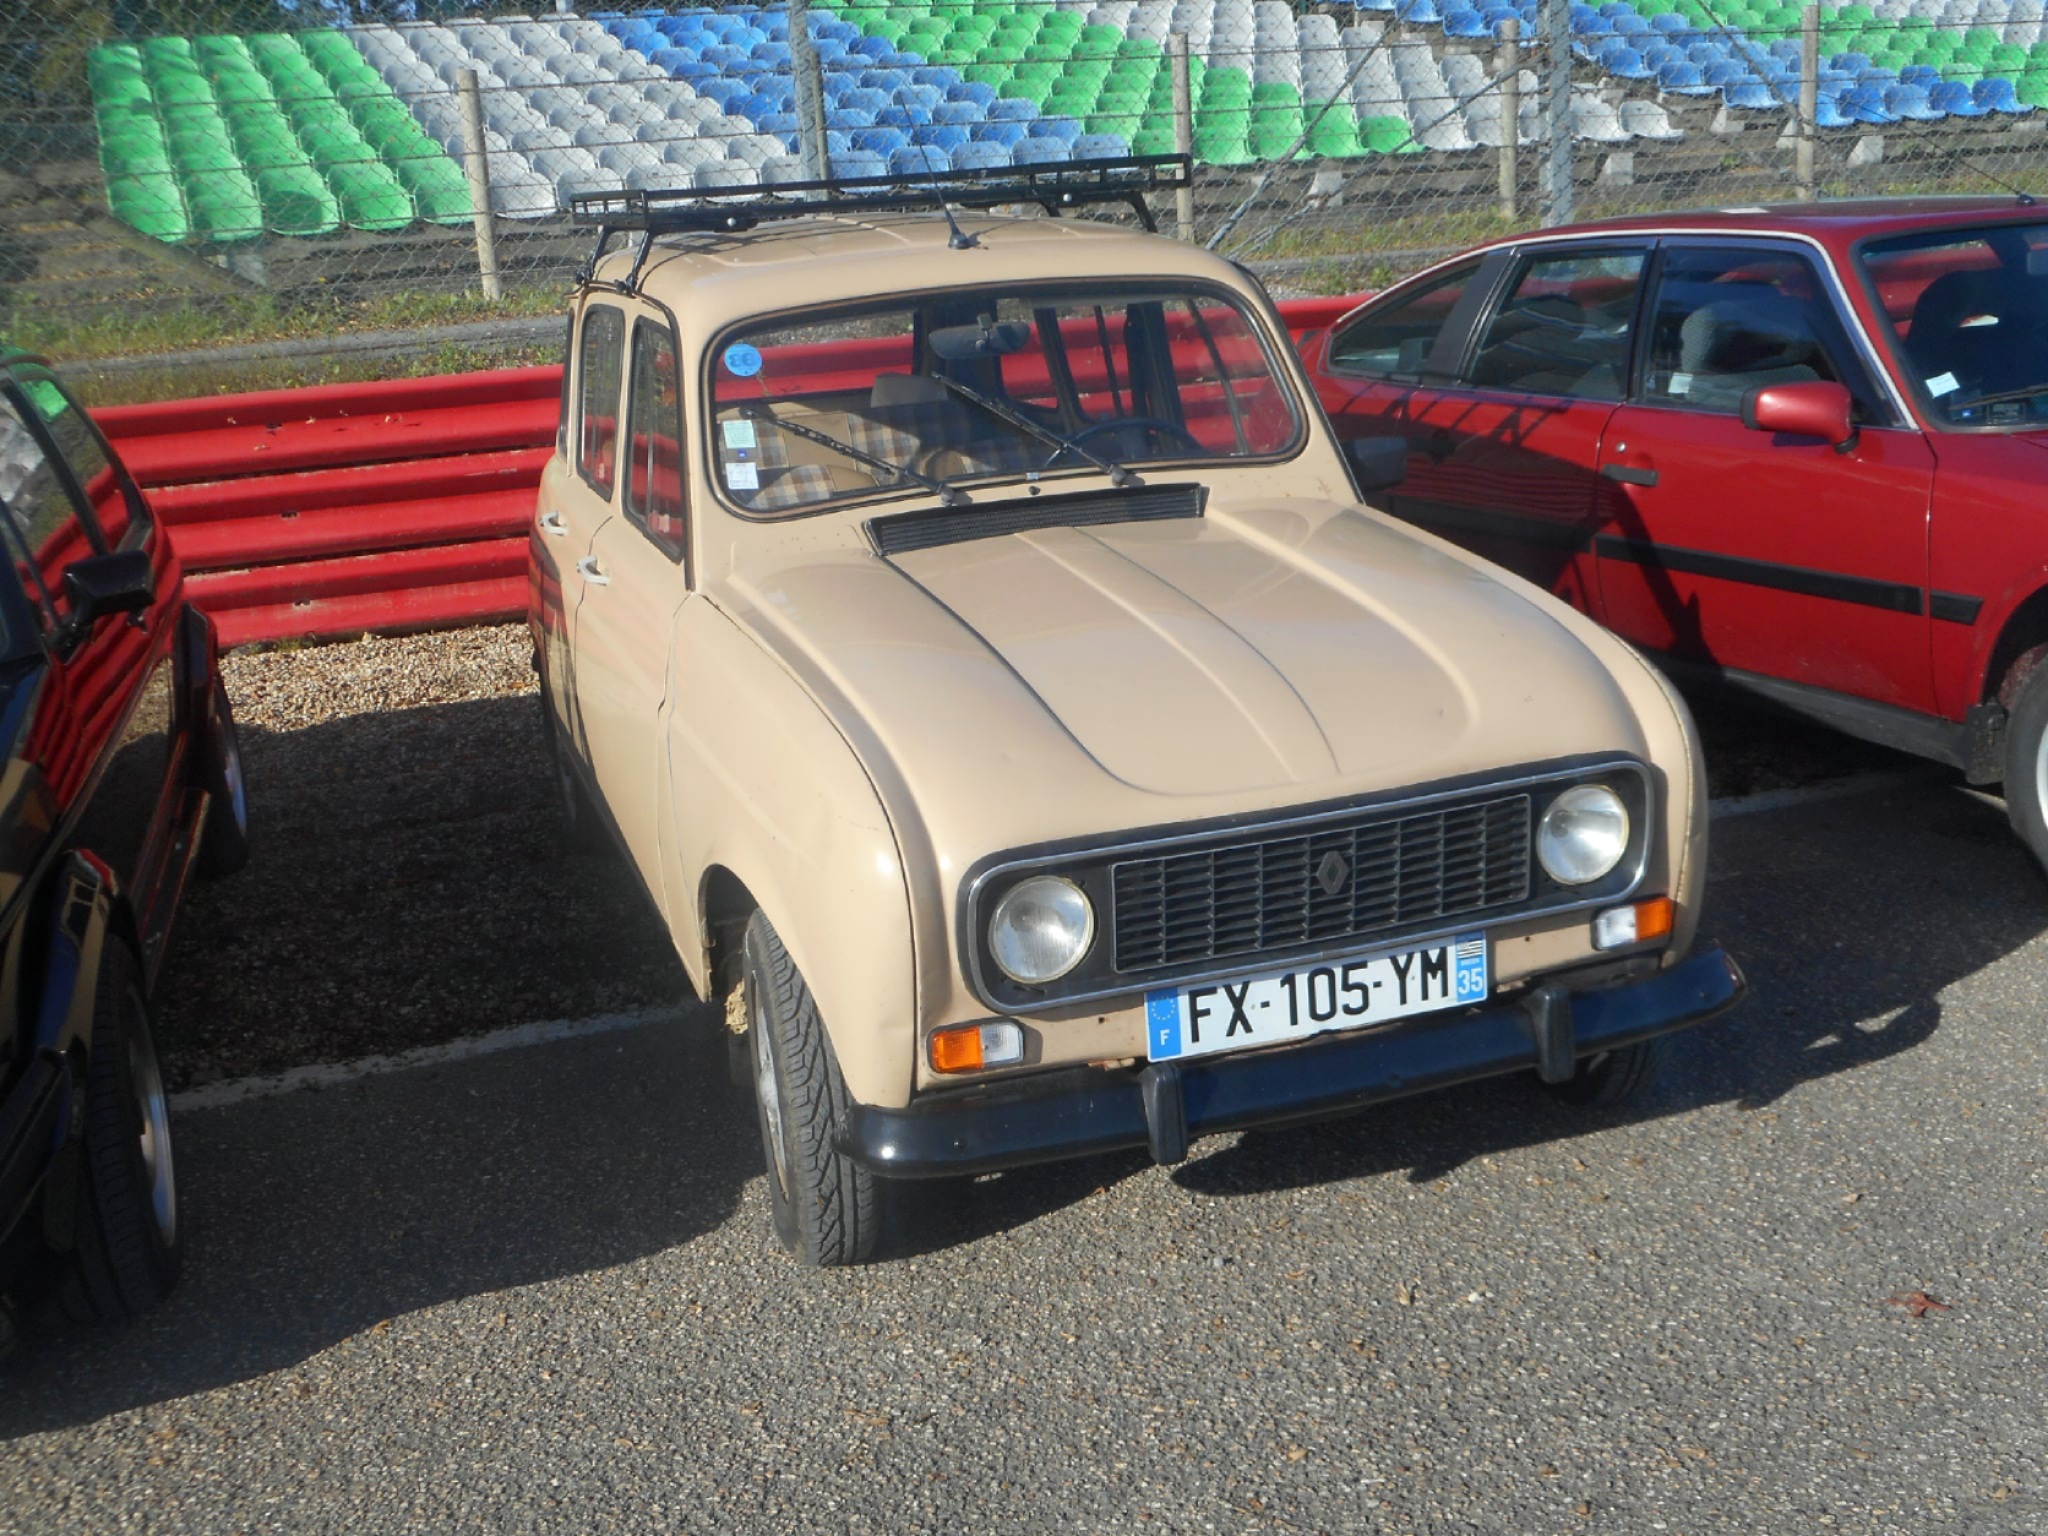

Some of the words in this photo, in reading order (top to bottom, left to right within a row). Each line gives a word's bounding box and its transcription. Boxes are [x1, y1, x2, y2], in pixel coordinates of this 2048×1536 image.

[1187, 945, 1450, 1044] FX-105-YM
[1458, 967, 1483, 995] 35
[1159, 1028, 1170, 1046] F
